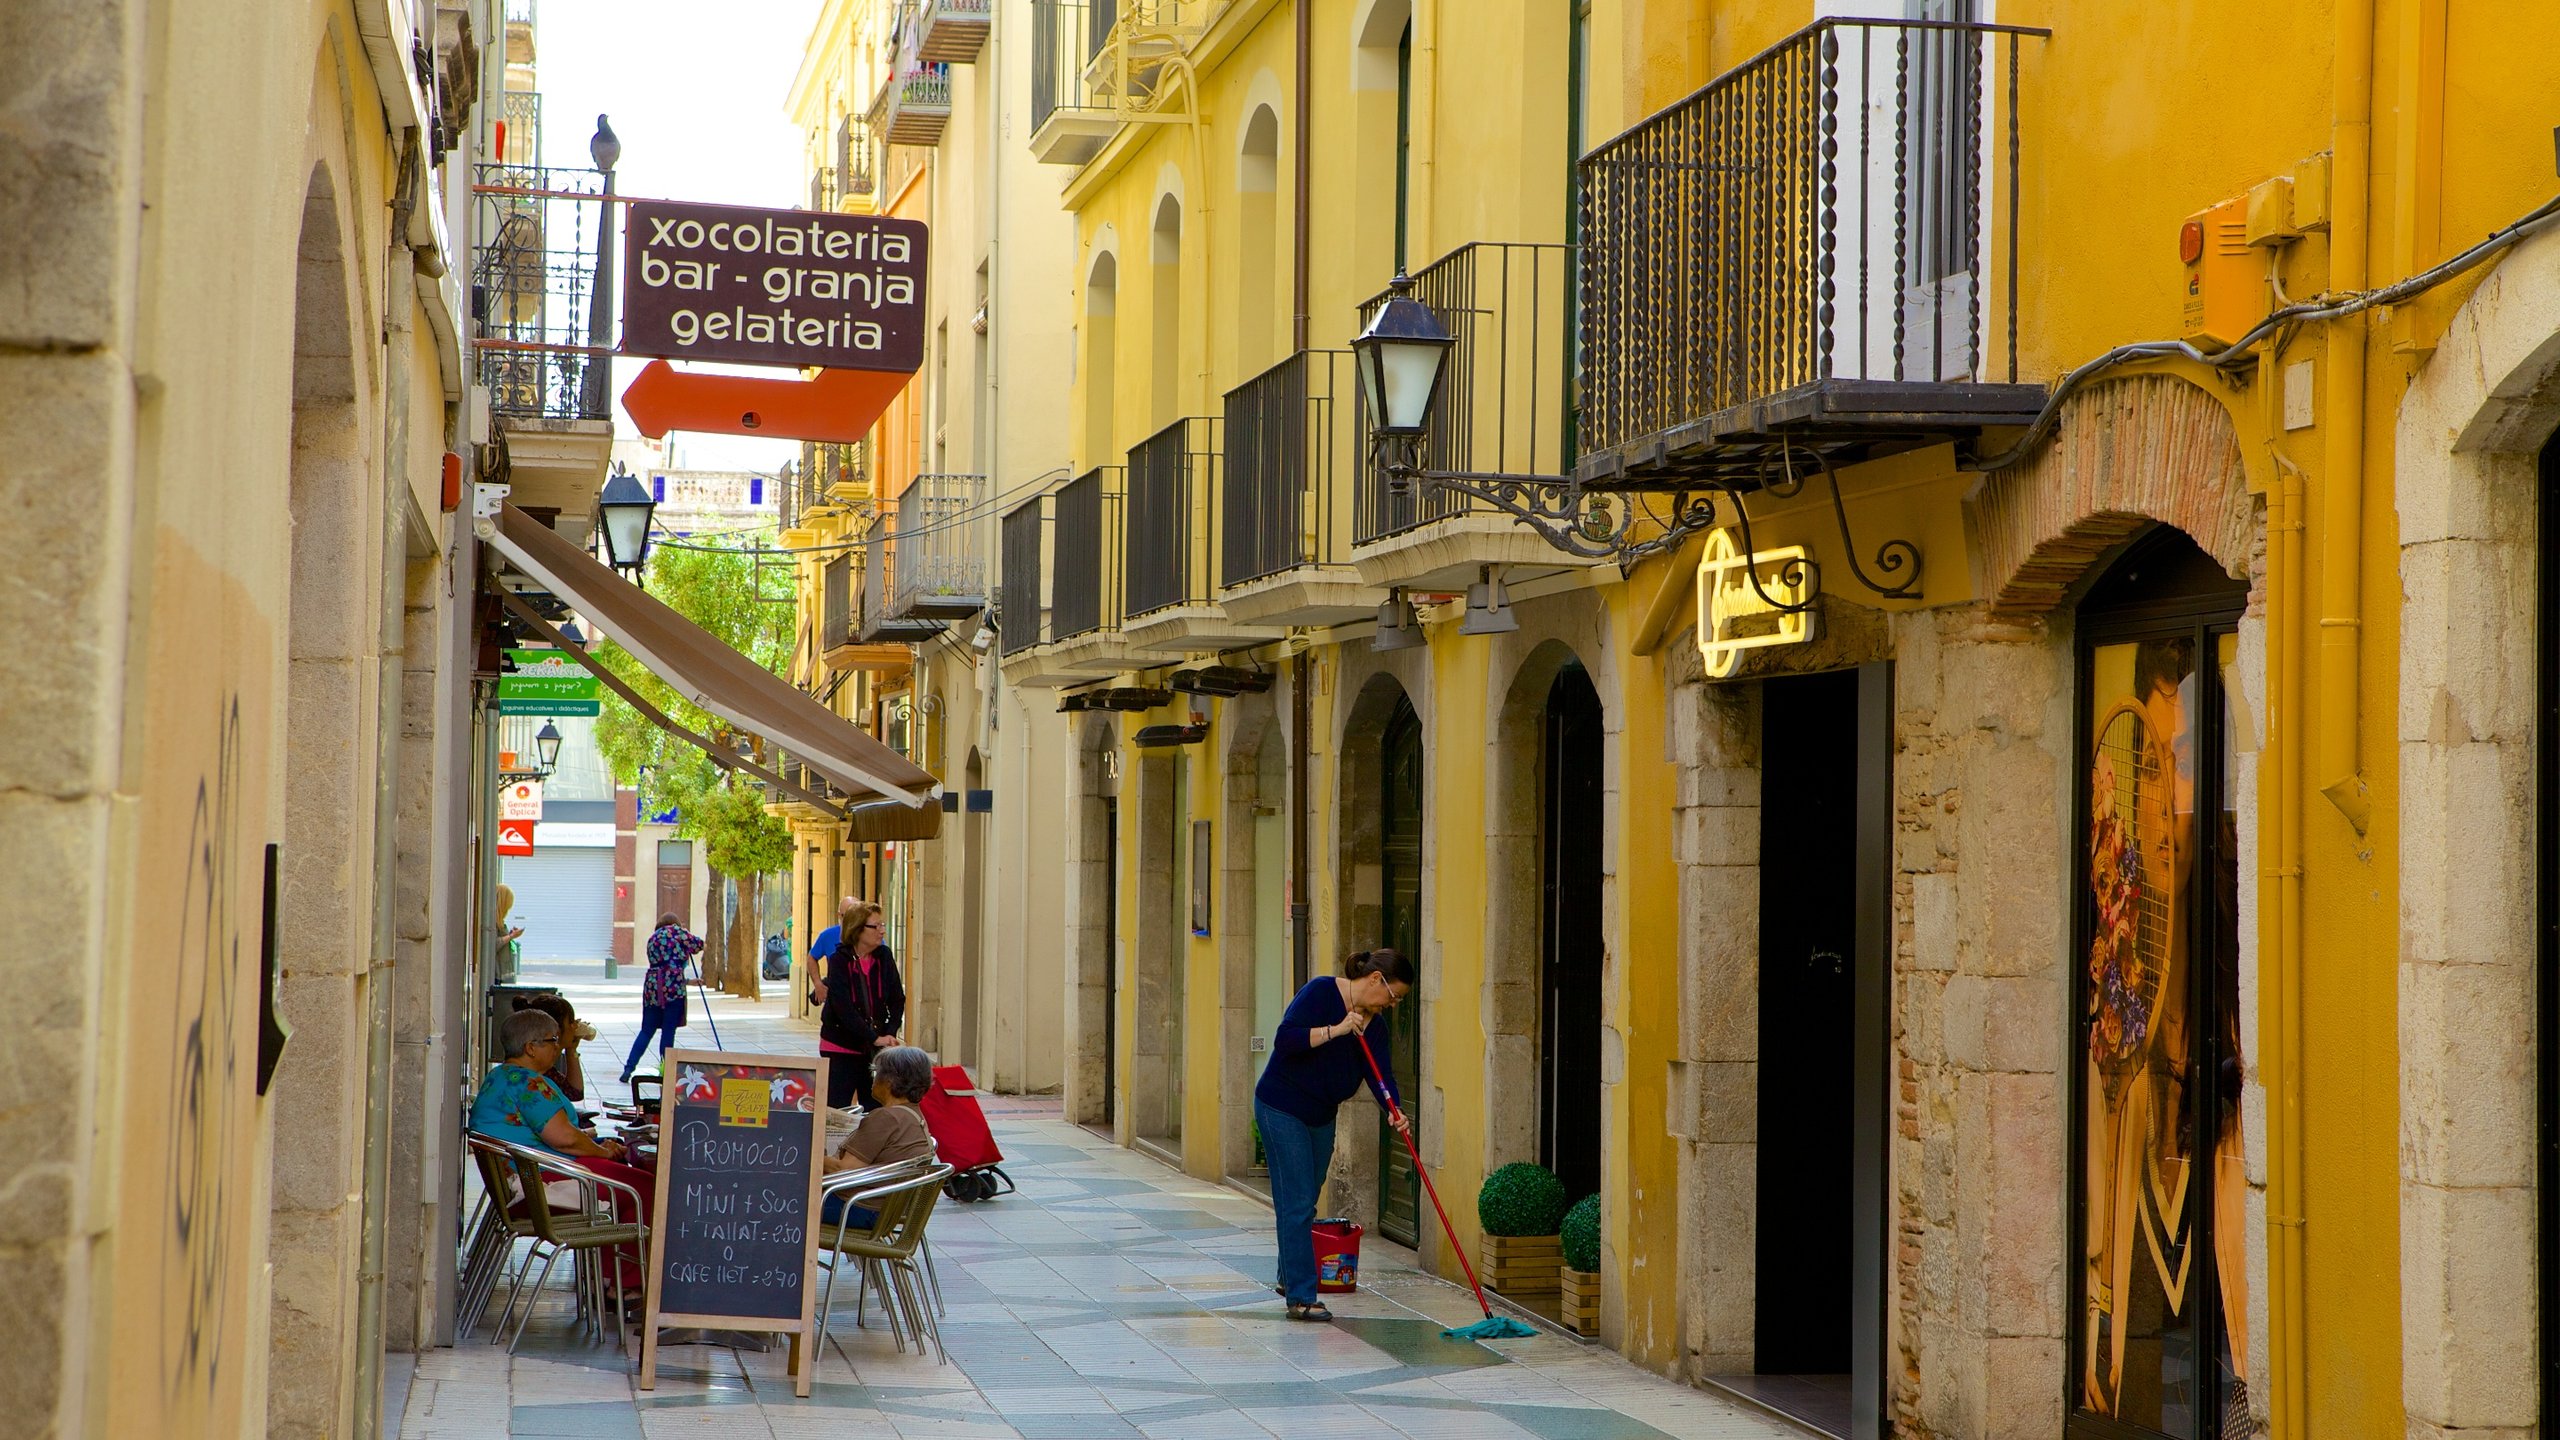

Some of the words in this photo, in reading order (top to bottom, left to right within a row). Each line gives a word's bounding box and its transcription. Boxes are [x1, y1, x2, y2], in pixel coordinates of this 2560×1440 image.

[649, 217, 911, 263] xocolateria
[641, 250, 721, 291] bar
[735, 274, 748, 283] -
[763, 266, 914, 310] granja
[670, 306, 883, 351] gelateria
[744, 1195, 753, 1214] +
[677, 1221, 689, 1239] +
